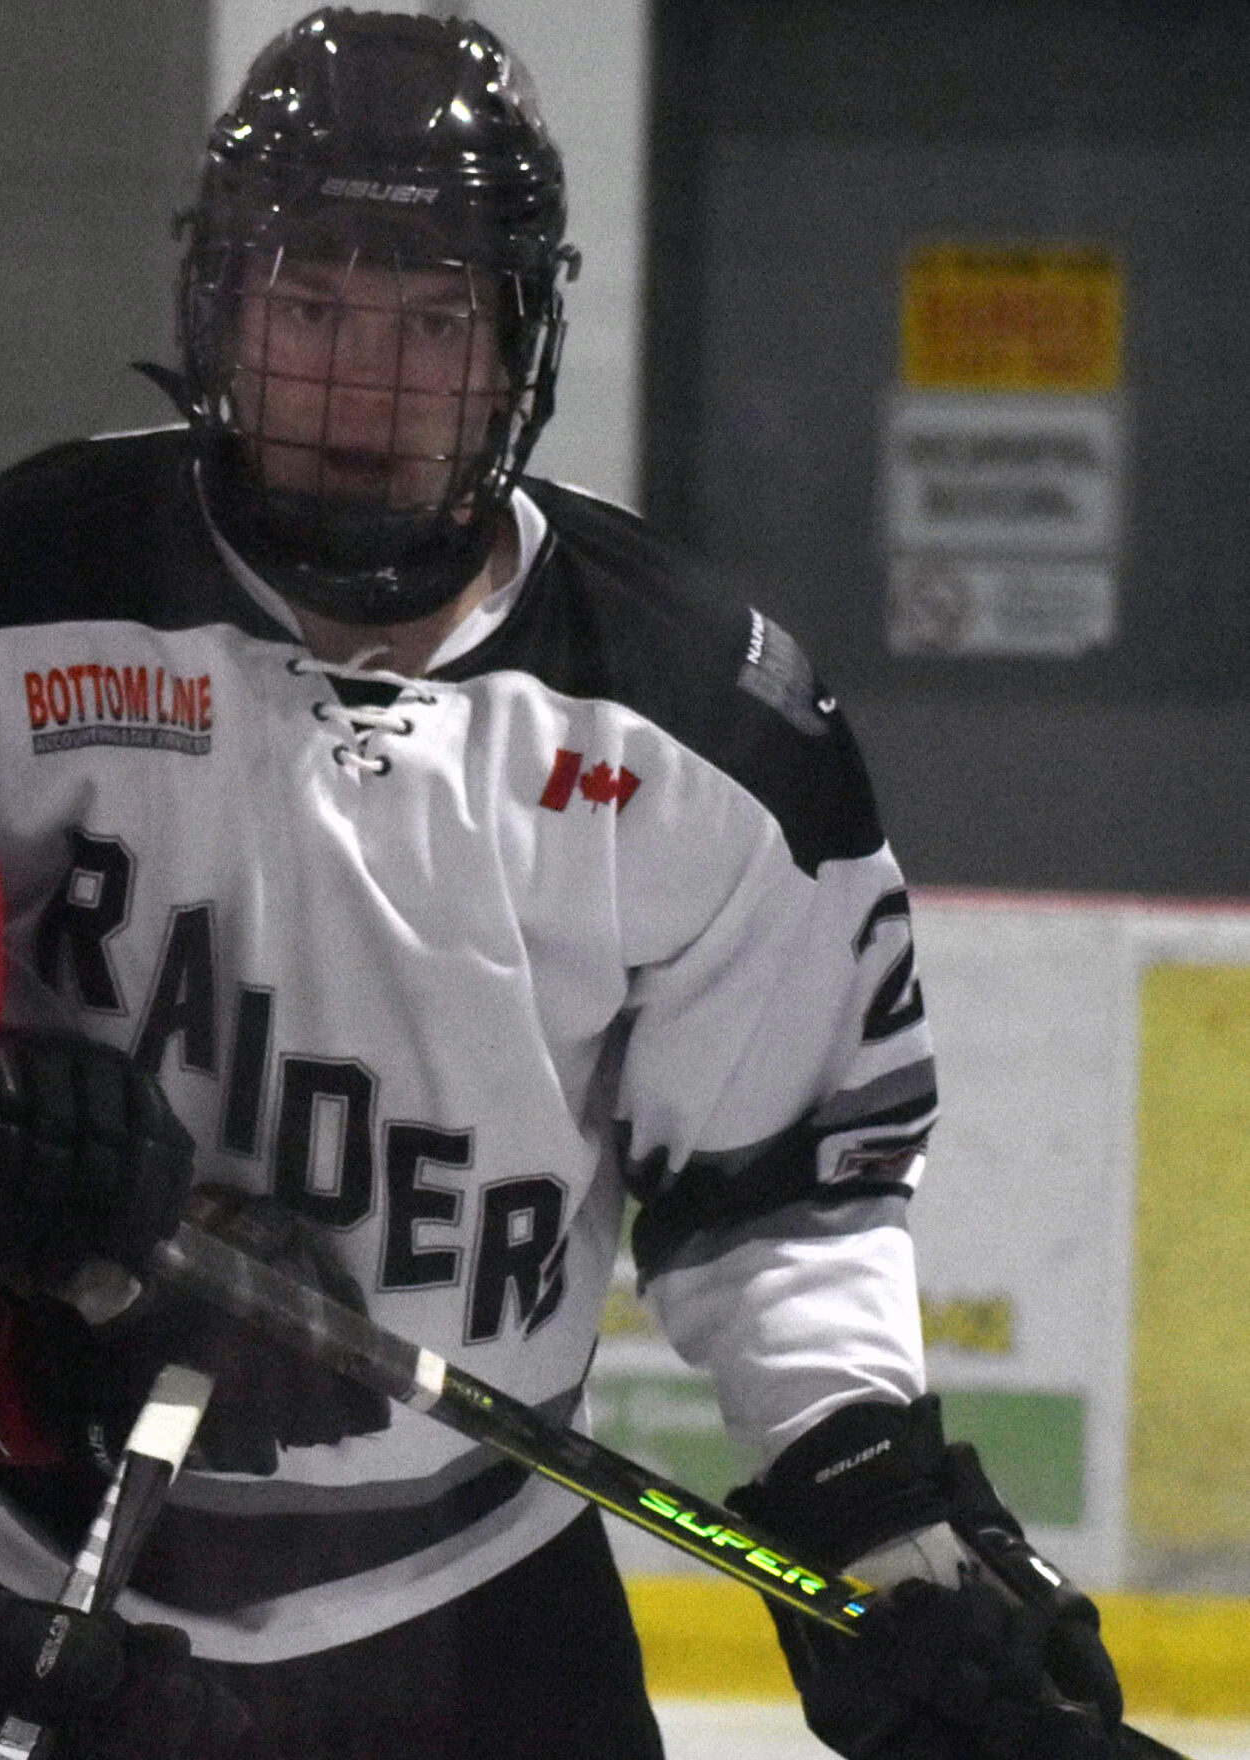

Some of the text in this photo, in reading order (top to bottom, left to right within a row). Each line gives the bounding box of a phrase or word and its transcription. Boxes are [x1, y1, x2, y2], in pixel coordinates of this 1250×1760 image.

[25, 663, 212, 732] BOTTOM LINE
[638, 1486, 829, 1597] SUPER
